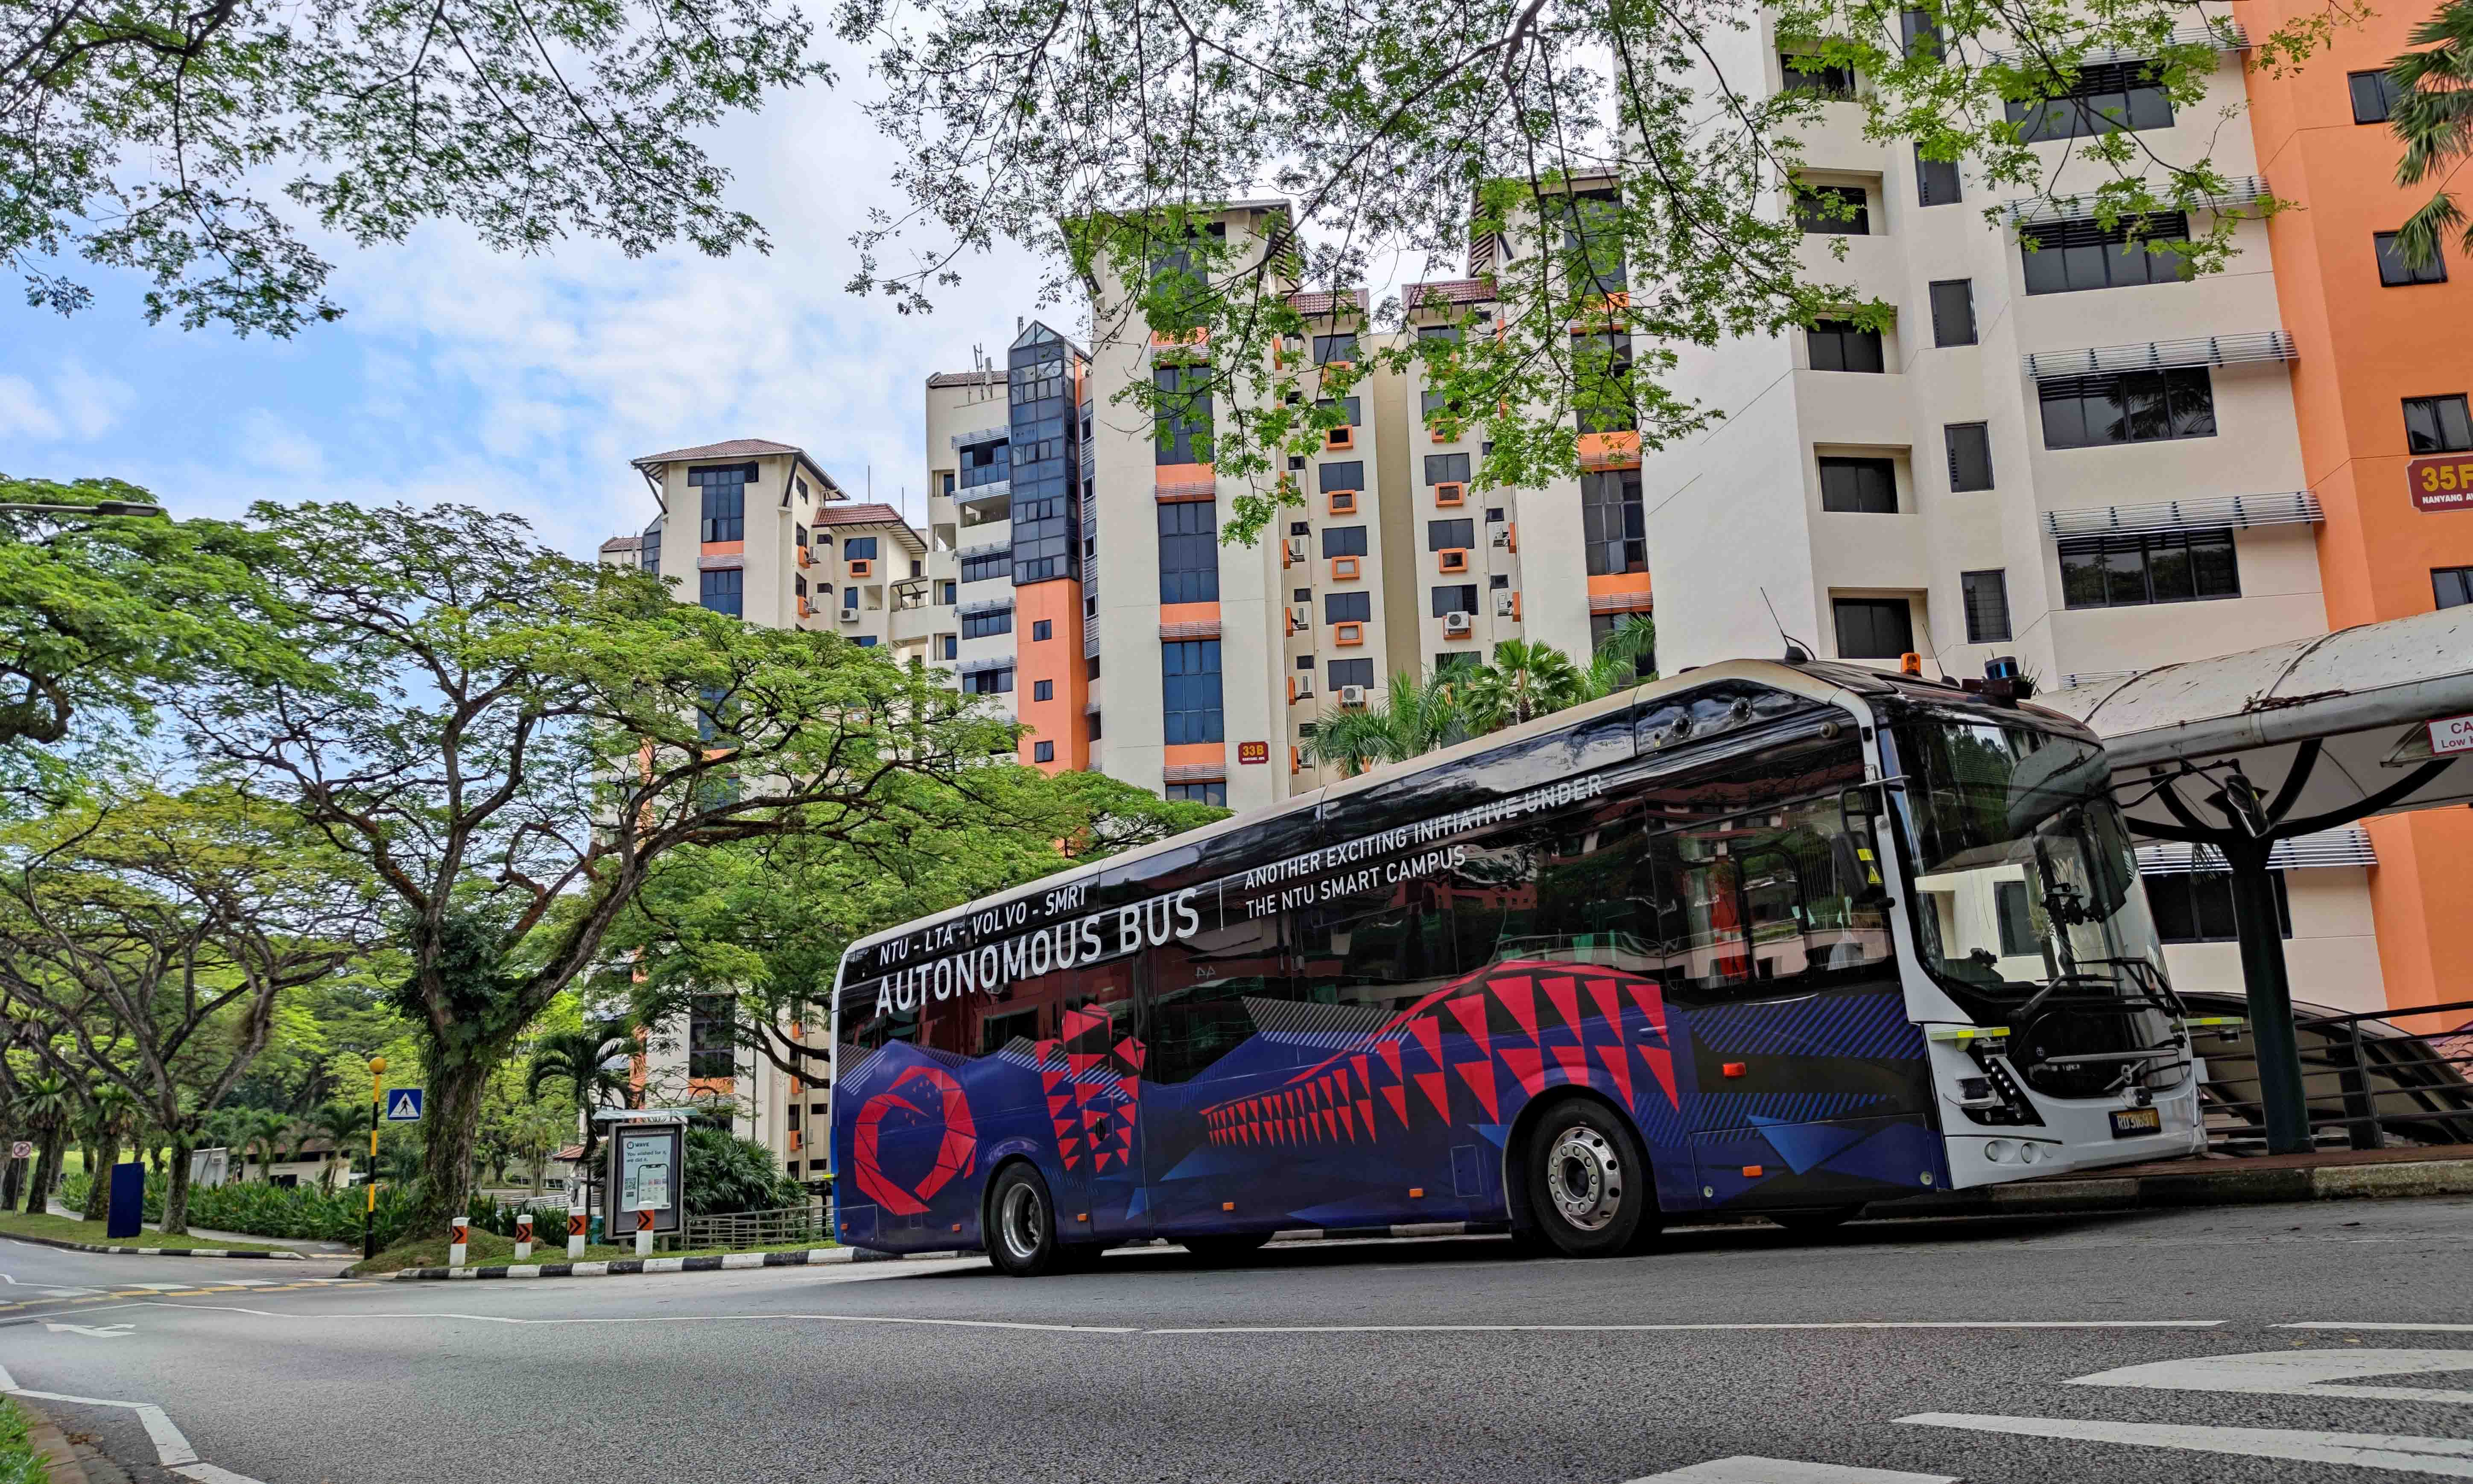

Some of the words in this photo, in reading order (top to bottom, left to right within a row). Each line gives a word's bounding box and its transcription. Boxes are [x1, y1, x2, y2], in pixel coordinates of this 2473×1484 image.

[2422, 494, 2463, 504] NANYANG
[1243, 745, 1264, 756] 33B
[2441, 739, 2465, 748] Low
[1245, 853, 1320, 891] ANOTHER
[1327, 829, 1407, 868] EXCITING
[1414, 796, 1518, 844] INITIATIVE
[1525, 774, 1602, 813] UNDER
[1246, 895, 1276, 919] THE
[1281, 882, 1314, 910] NTU
[1320, 867, 1379, 900] SMART
[1387, 845, 1466, 883] CAMPUS
[875, 914, 1102, 1018] AUTONOMOUS
[1120, 888, 1199, 953] BUS
[880, 937, 909, 966] NTU
[925, 924, 953, 952] LTA
[973, 902, 1026, 937] VOLVO
[1046, 882, 1088, 916] SMRT
